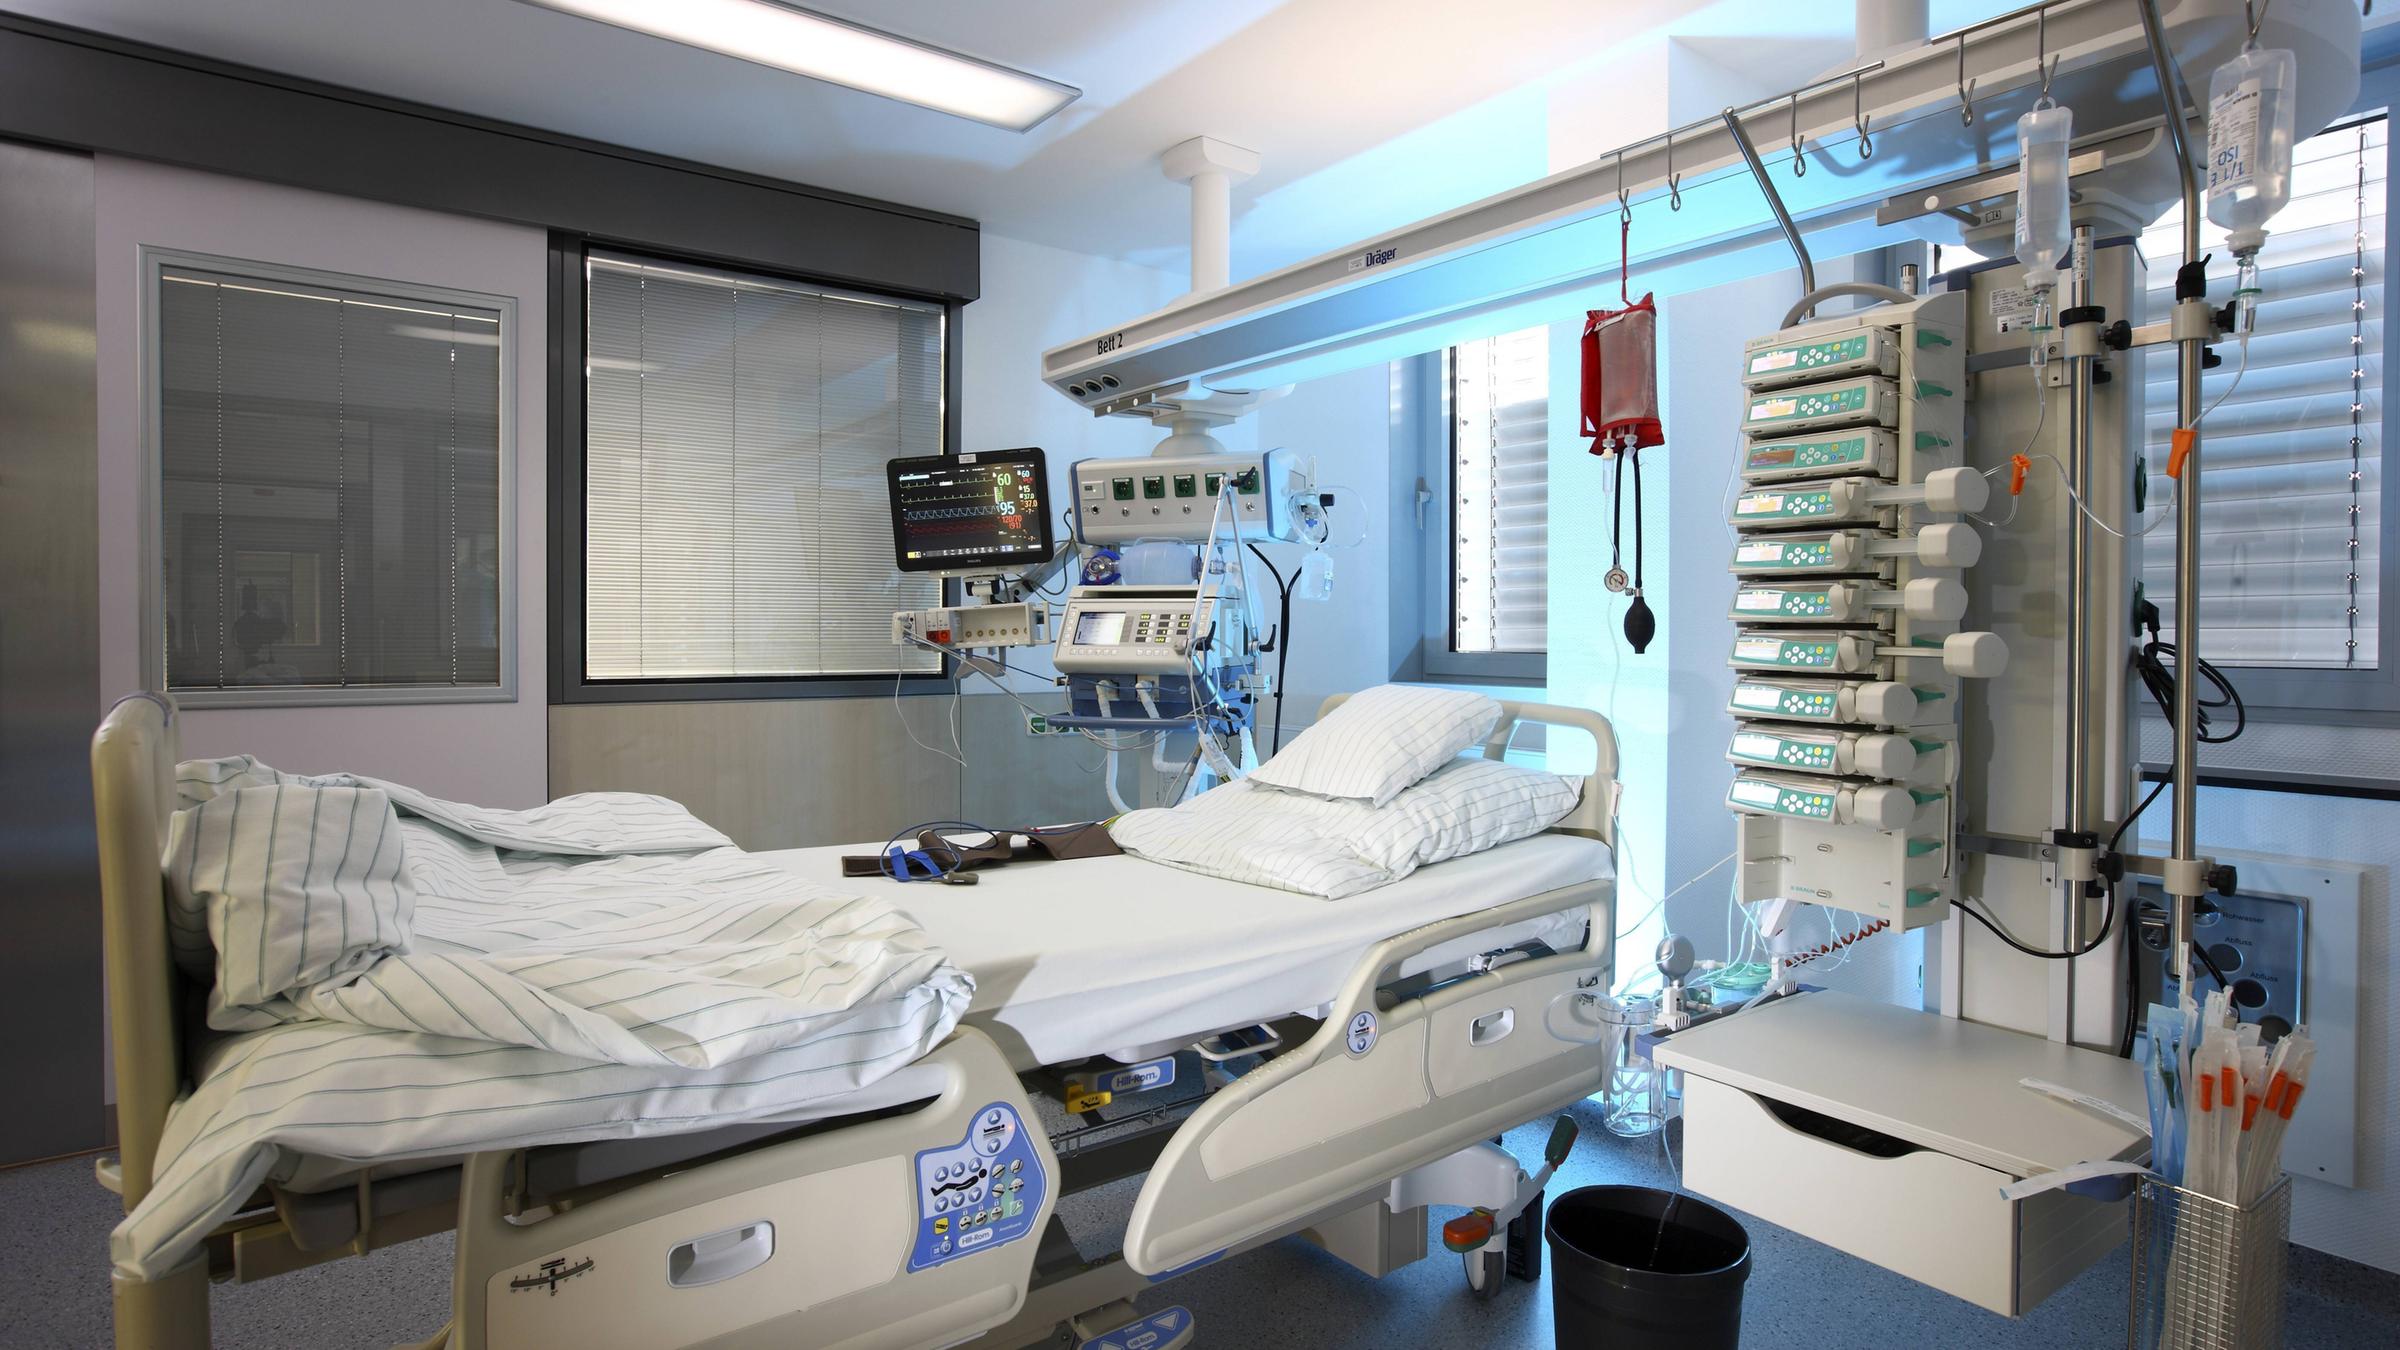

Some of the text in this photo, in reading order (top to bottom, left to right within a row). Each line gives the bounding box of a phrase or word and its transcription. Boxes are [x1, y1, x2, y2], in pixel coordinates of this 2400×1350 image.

[2218, 145, 2239, 166] ISO
[1366, 248, 1397, 267] Dräger
[1097, 333, 1123, 355] Bett 2
[997, 473, 1011, 486] 60
[1021, 470, 1030, 478] 60
[1023, 485, 1030, 493] 15
[1000, 501, 1015, 516] 95
[1024, 500, 1038, 508] 37.0
[1001, 514, 1023, 524] 120/70
